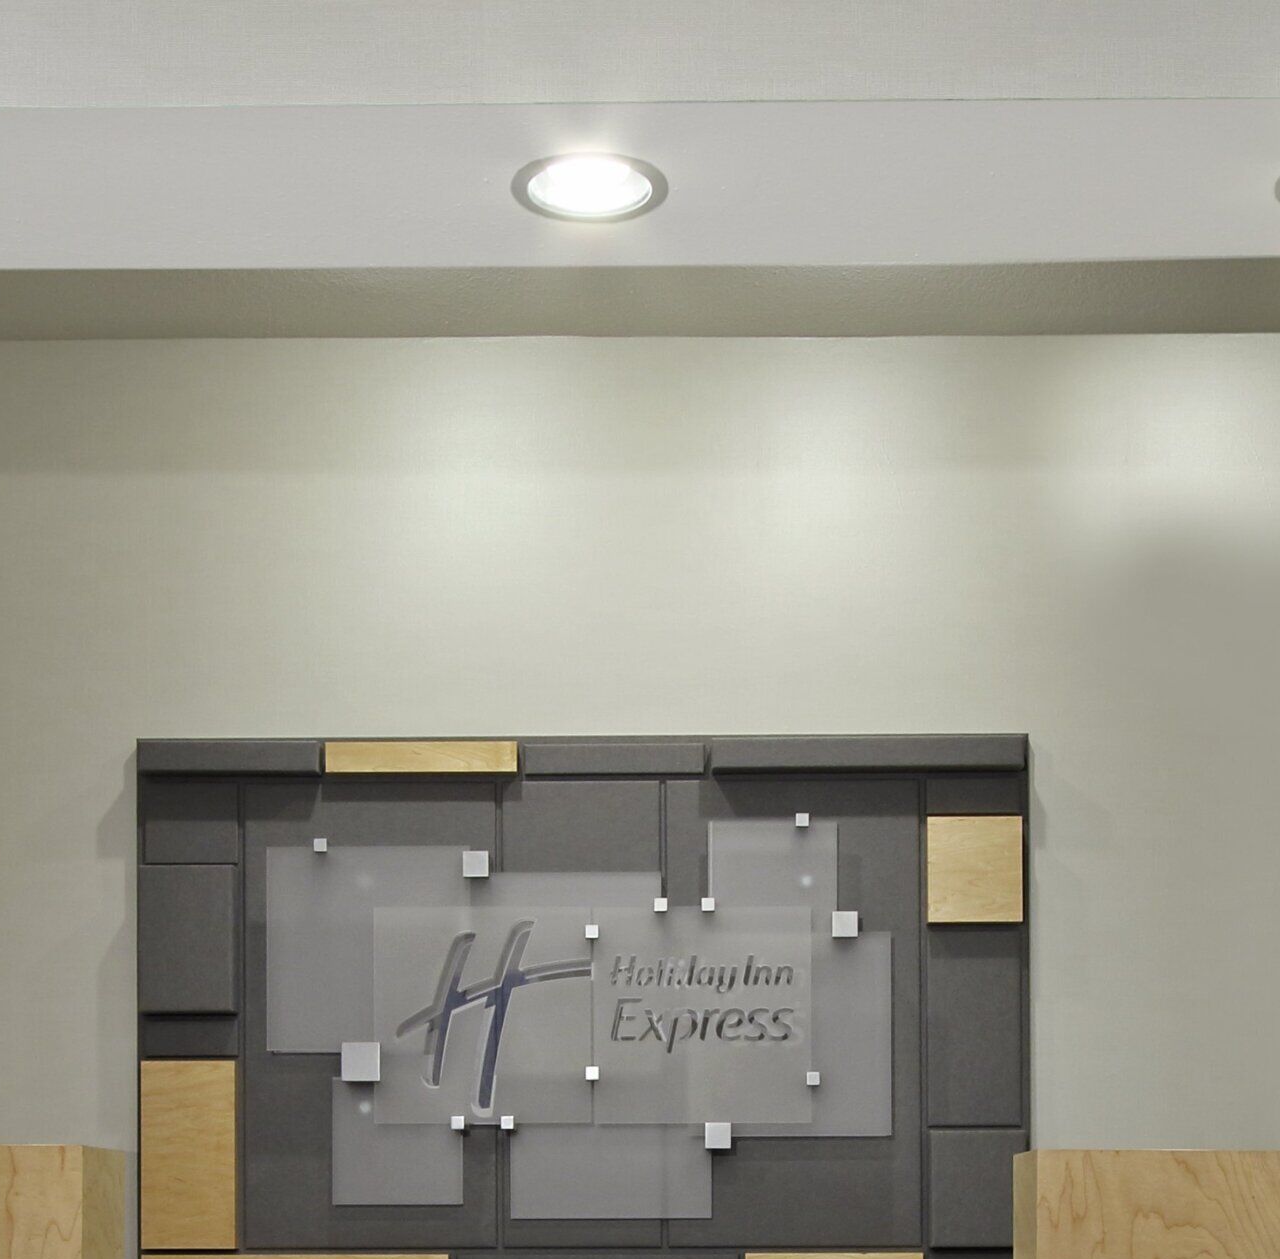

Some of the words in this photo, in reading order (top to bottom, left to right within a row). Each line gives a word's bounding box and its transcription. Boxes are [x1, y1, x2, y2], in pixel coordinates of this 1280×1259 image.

[610, 953, 738, 993] Holiday
[742, 953, 795, 987] Inn
[610, 998, 795, 1053] Express
